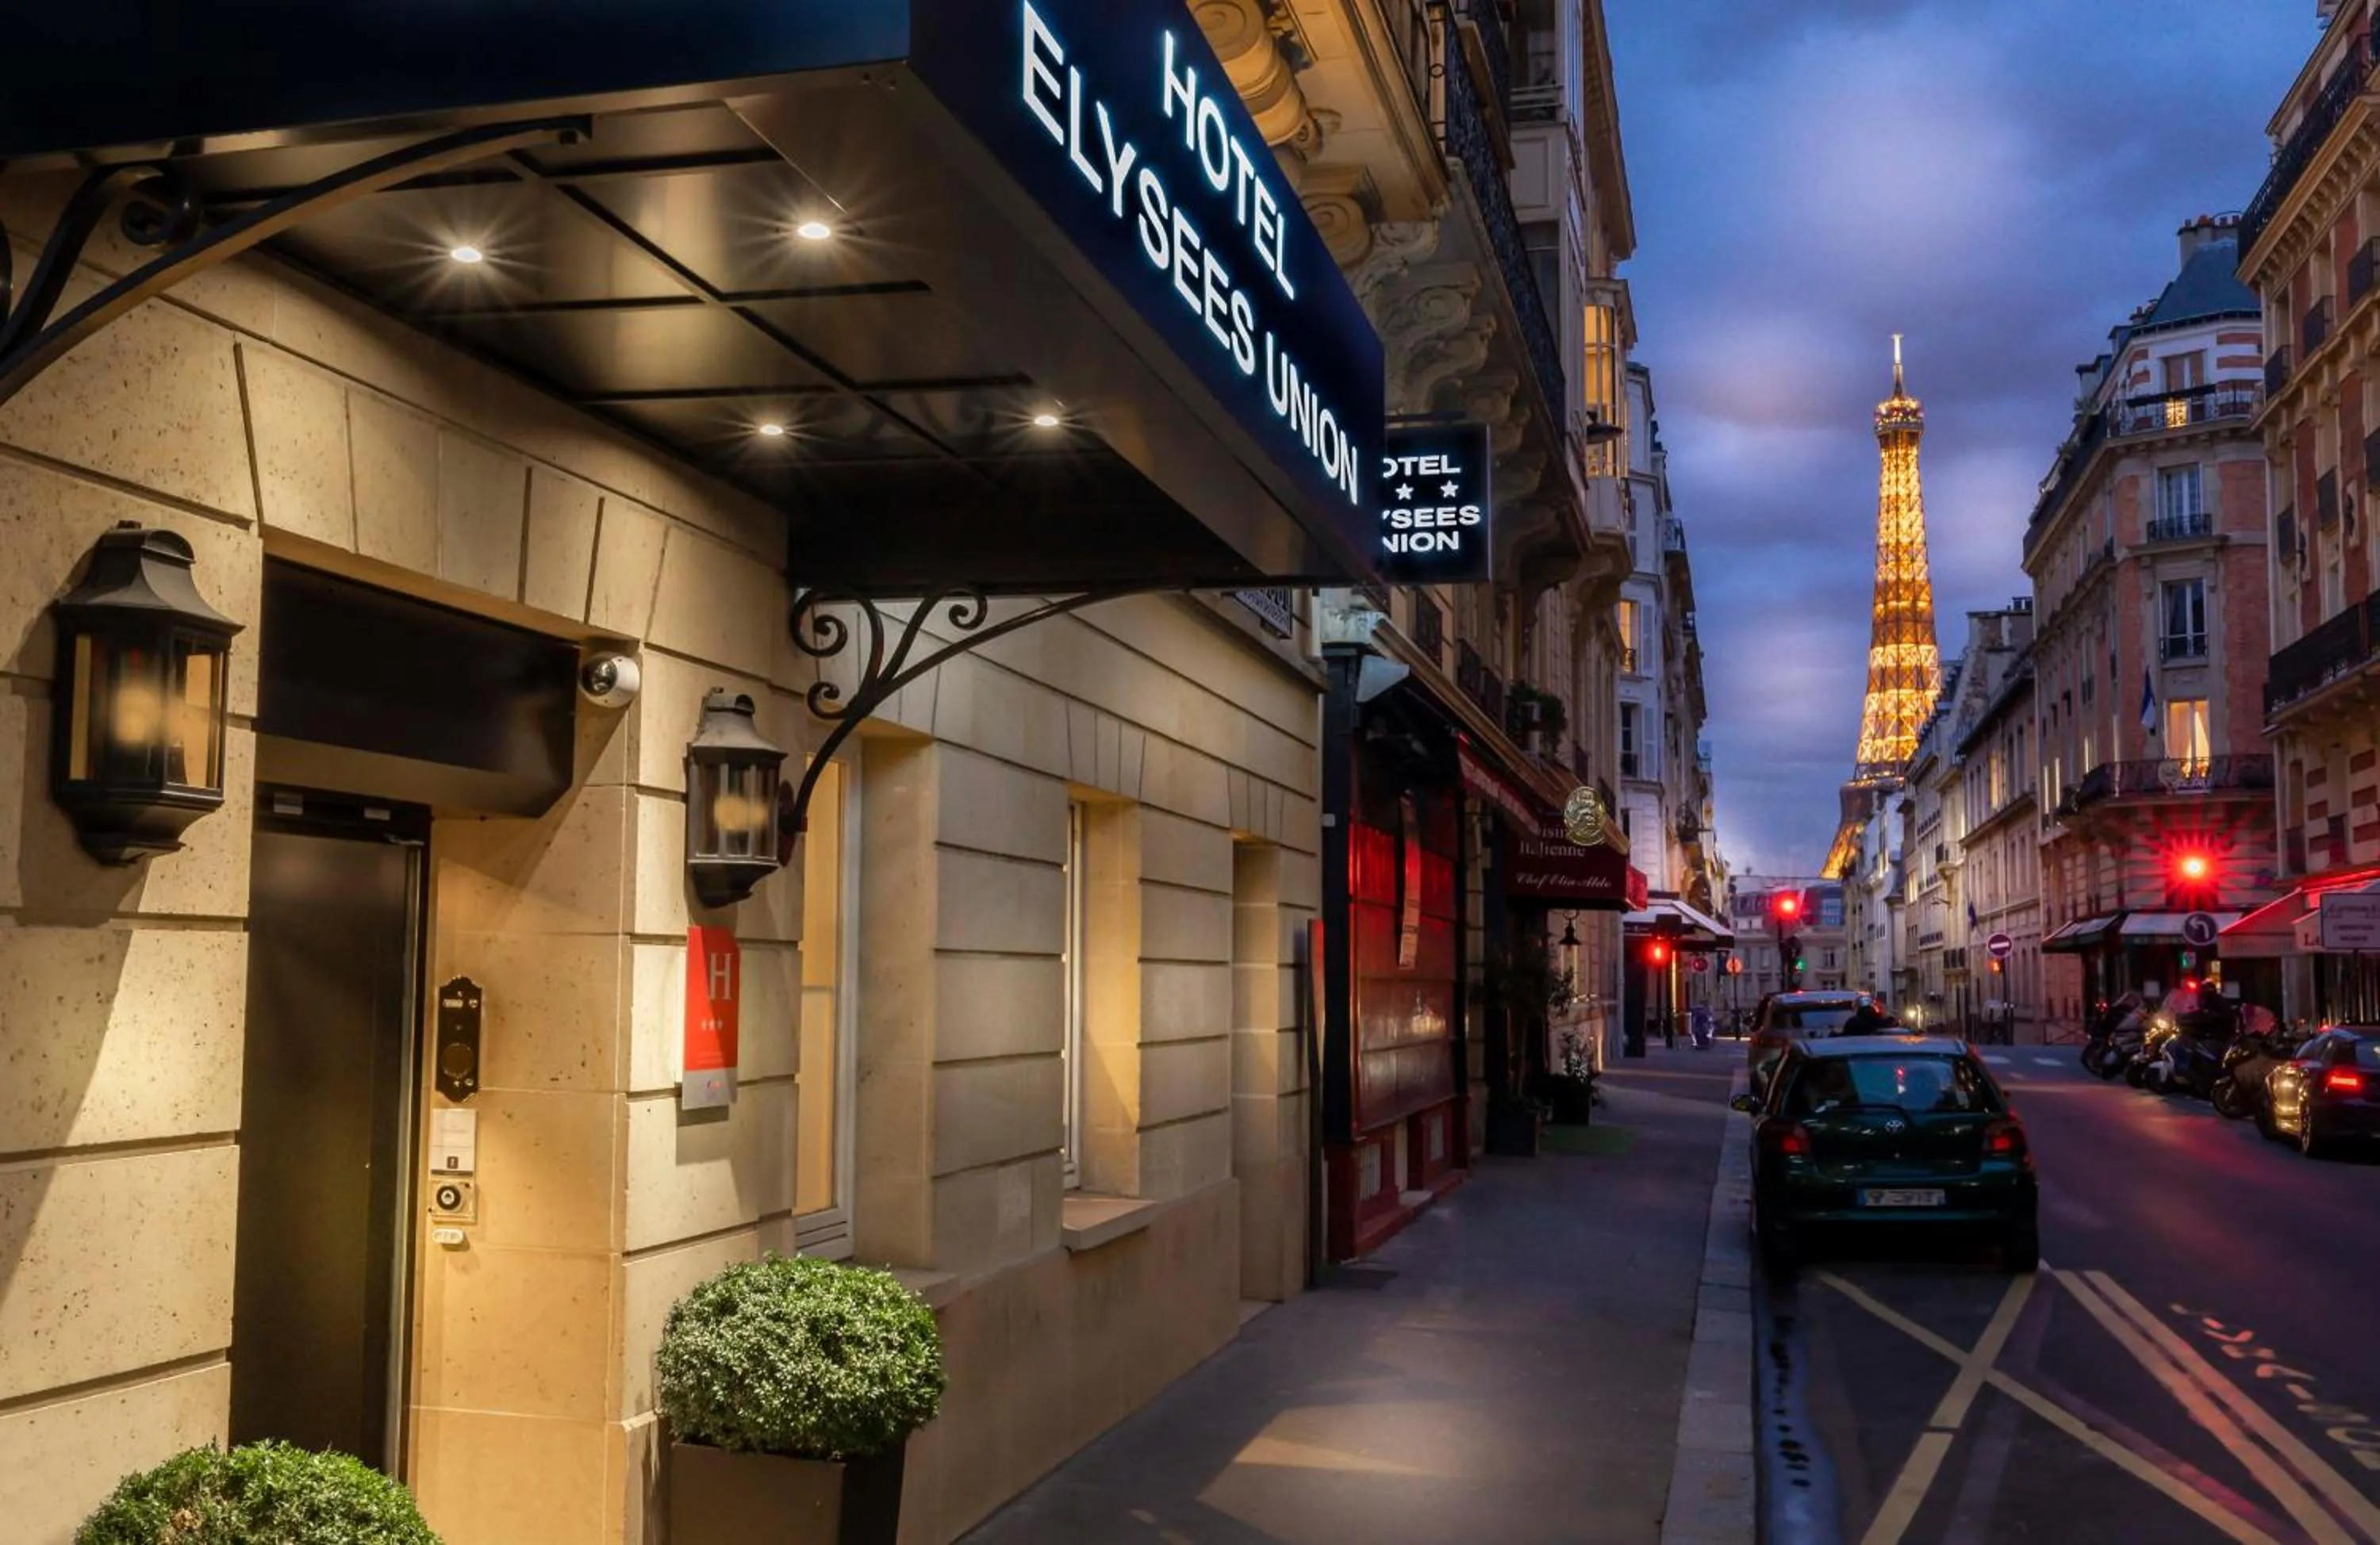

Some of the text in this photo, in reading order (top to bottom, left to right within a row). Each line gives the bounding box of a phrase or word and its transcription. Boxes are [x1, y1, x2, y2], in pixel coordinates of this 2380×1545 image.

[1023, 0, 1357, 506] ELYSEES UNION
[1163, 30, 1294, 300] HOTEL
[709, 953, 732, 1000] H
